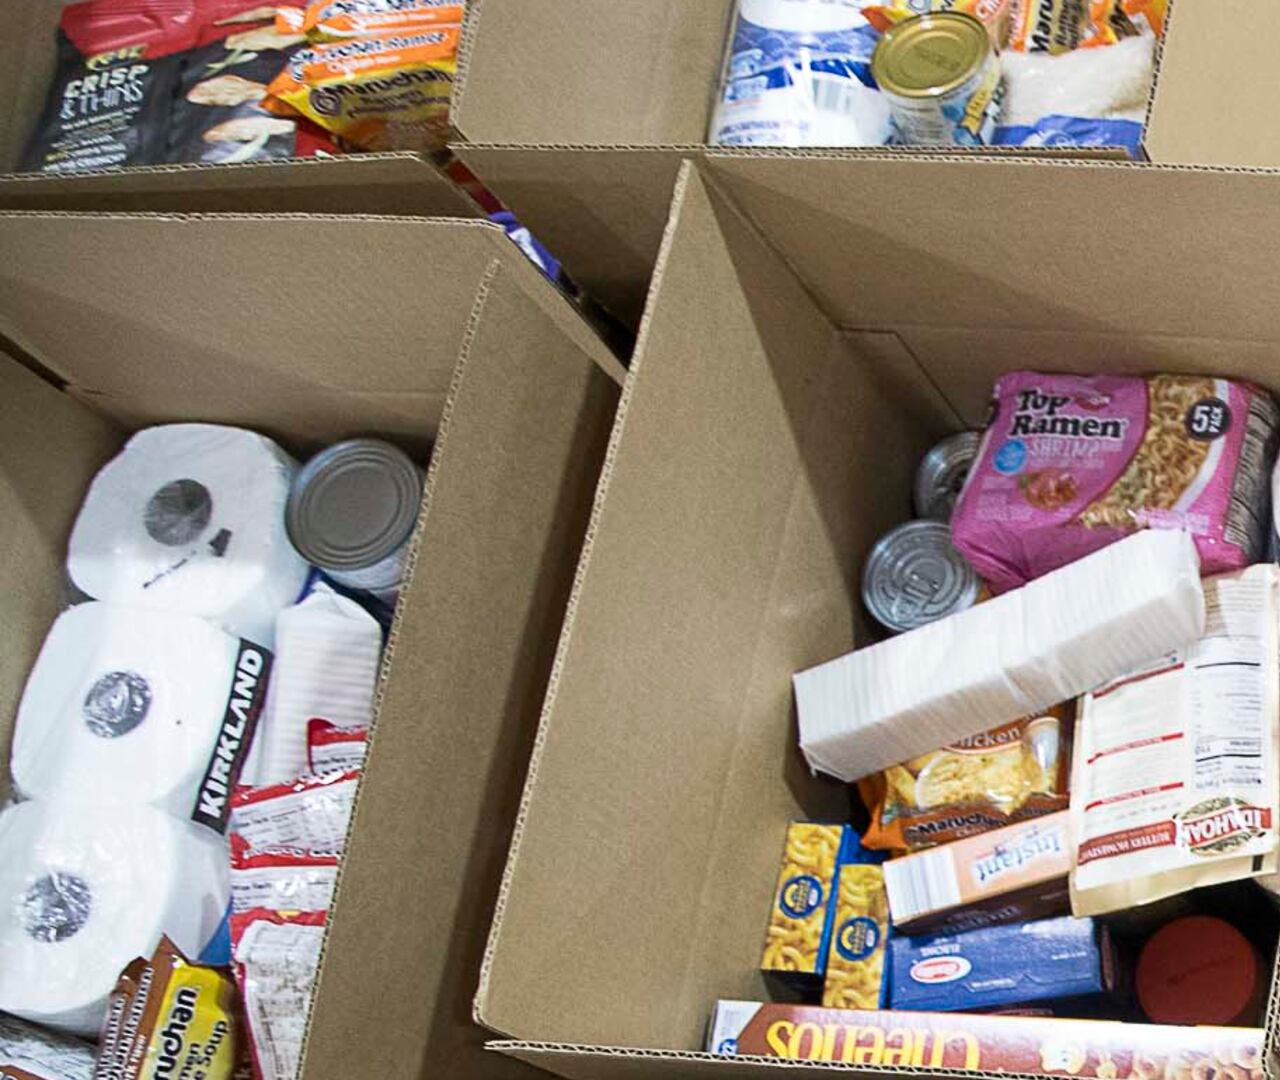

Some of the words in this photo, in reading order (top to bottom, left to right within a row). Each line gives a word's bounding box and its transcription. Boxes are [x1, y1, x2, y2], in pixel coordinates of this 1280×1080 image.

[67, 64, 149, 98] CRISP
[1017, 390, 1071, 414] Top
[1191, 405, 1208, 433] 5
[1208, 406, 1224, 433] PACK
[1010, 414, 1124, 438] Ramen
[201, 648, 264, 820] KIRKLAND
[1178, 803, 1270, 847] IDAHOAN
[976, 833, 1062, 881] Instant
[200, 1019, 230, 1066] Soup
[765, 1019, 982, 1072] Cheerios
